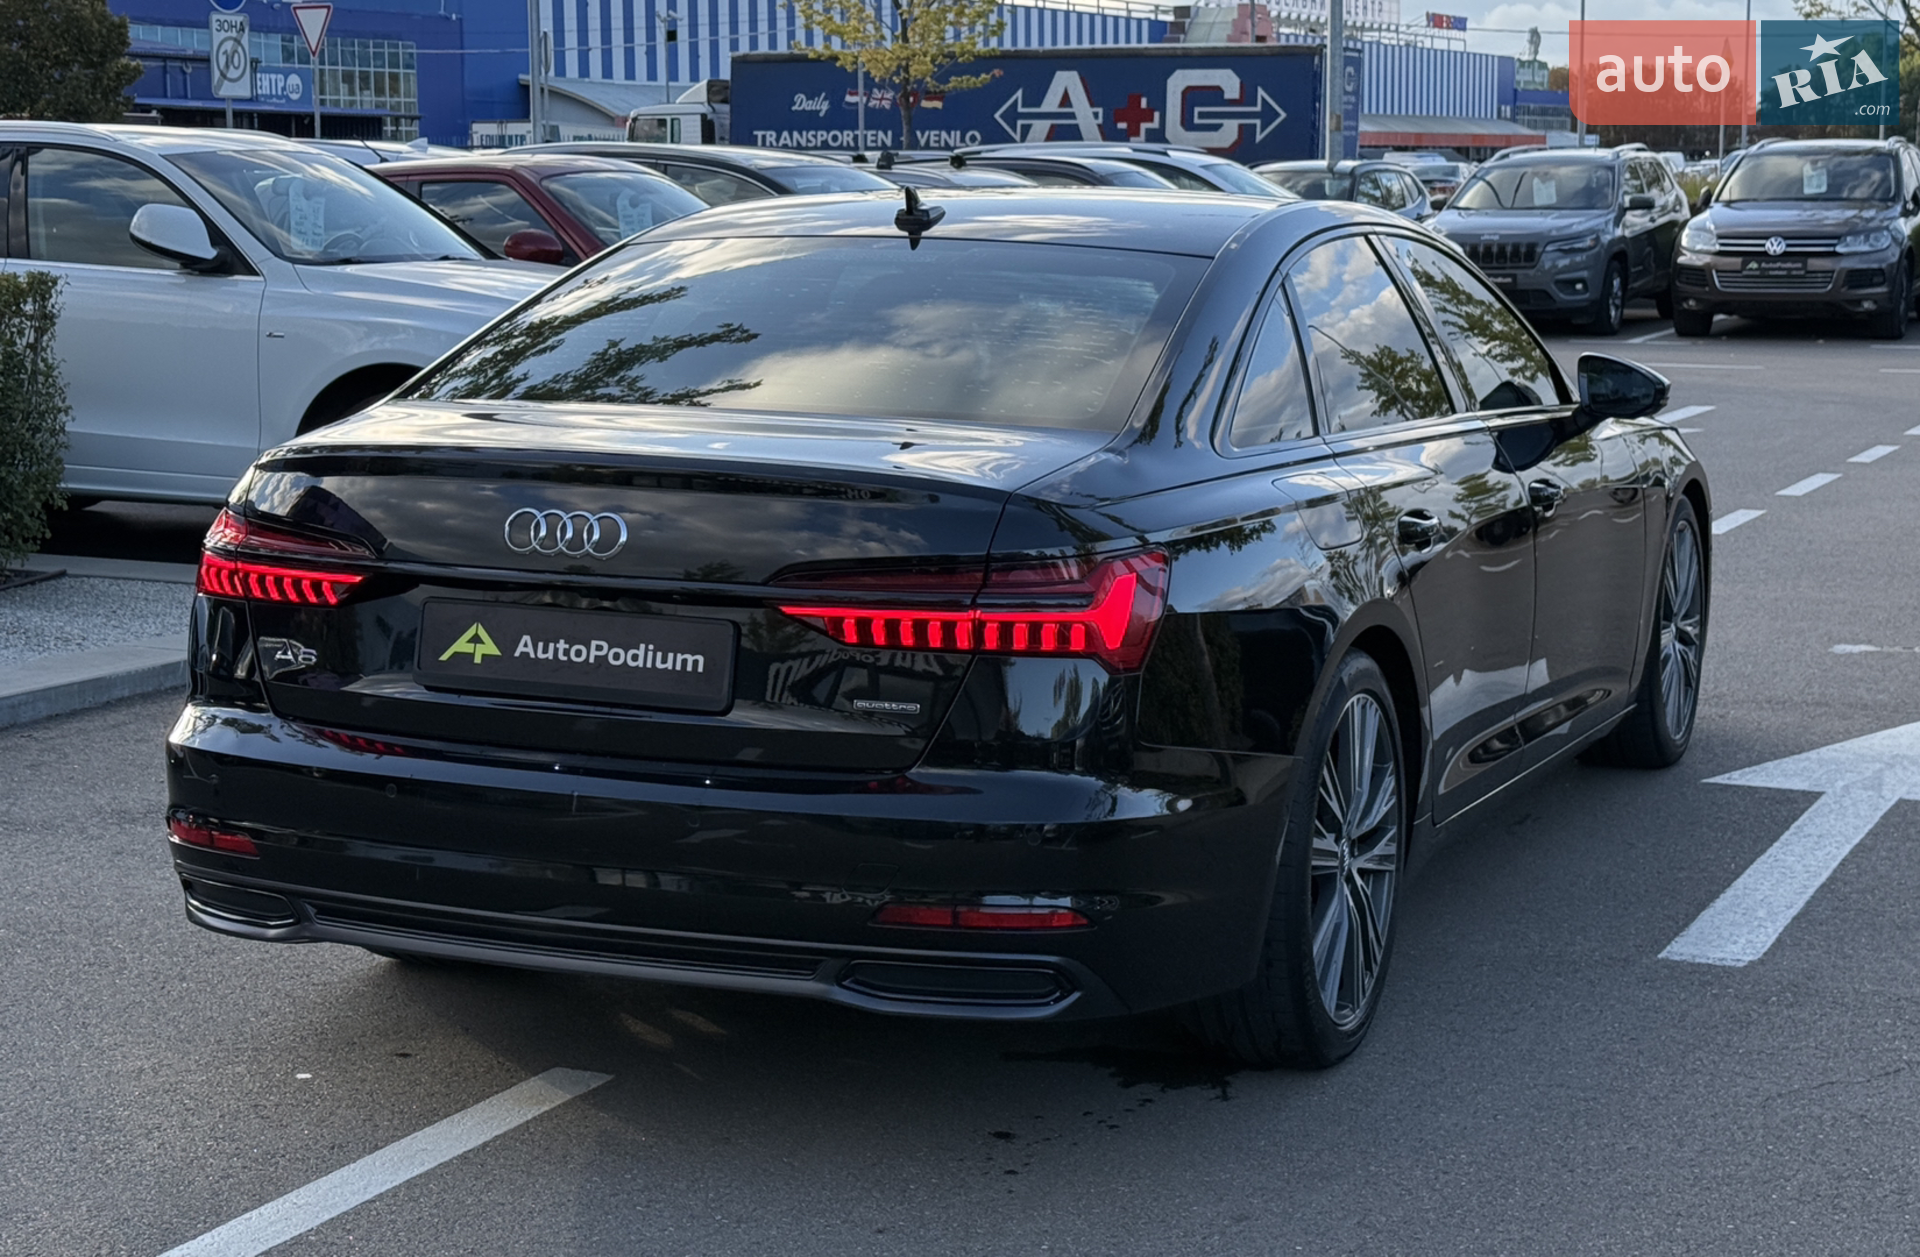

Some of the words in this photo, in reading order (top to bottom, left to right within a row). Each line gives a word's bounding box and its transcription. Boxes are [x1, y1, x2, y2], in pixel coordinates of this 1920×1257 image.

[215, 19, 245, 34] ЗОНА
[222, 49, 242, 71] 10
[791, 92, 830, 118] Daily
[753, 130, 893, 148] TRANSPORTEN
[916, 130, 982, 148] VENLO
[274, 638, 318, 666] A6
[514, 634, 705, 673] AutoPodium
[856, 701, 917, 712] quattro
